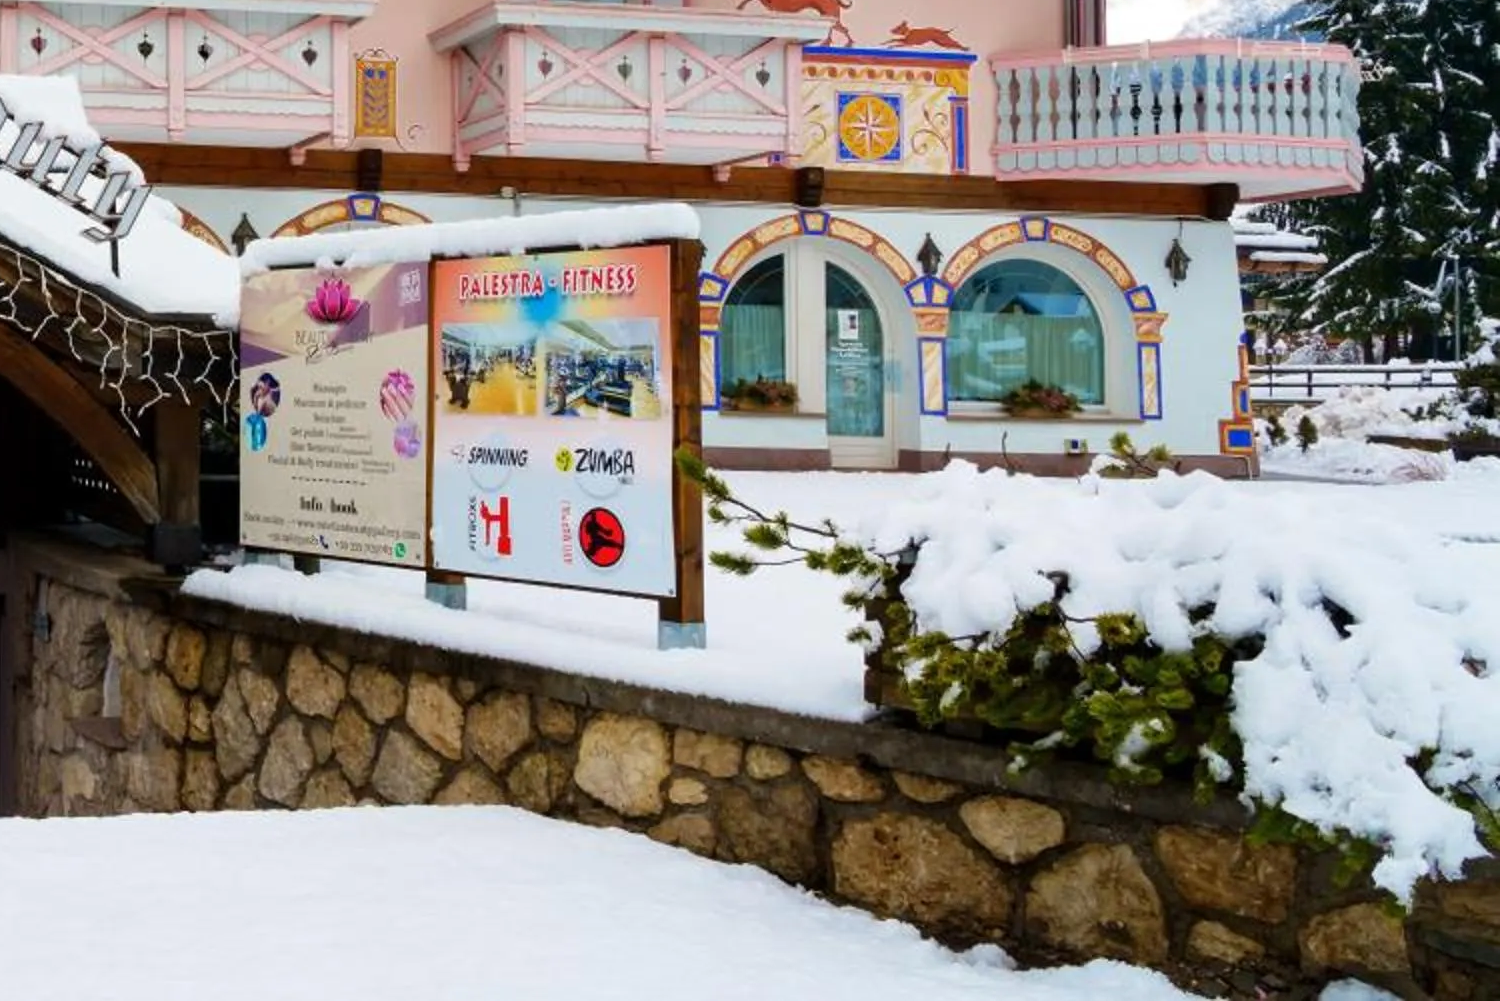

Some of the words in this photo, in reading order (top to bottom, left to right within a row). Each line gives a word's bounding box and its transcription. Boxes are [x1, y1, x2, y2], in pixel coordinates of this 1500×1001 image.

[460, 271, 545, 298] PALESTRA
[561, 265, 637, 294] FITNESS
[467, 446, 529, 468] SPINNING
[574, 447, 636, 477] ZUMBA
